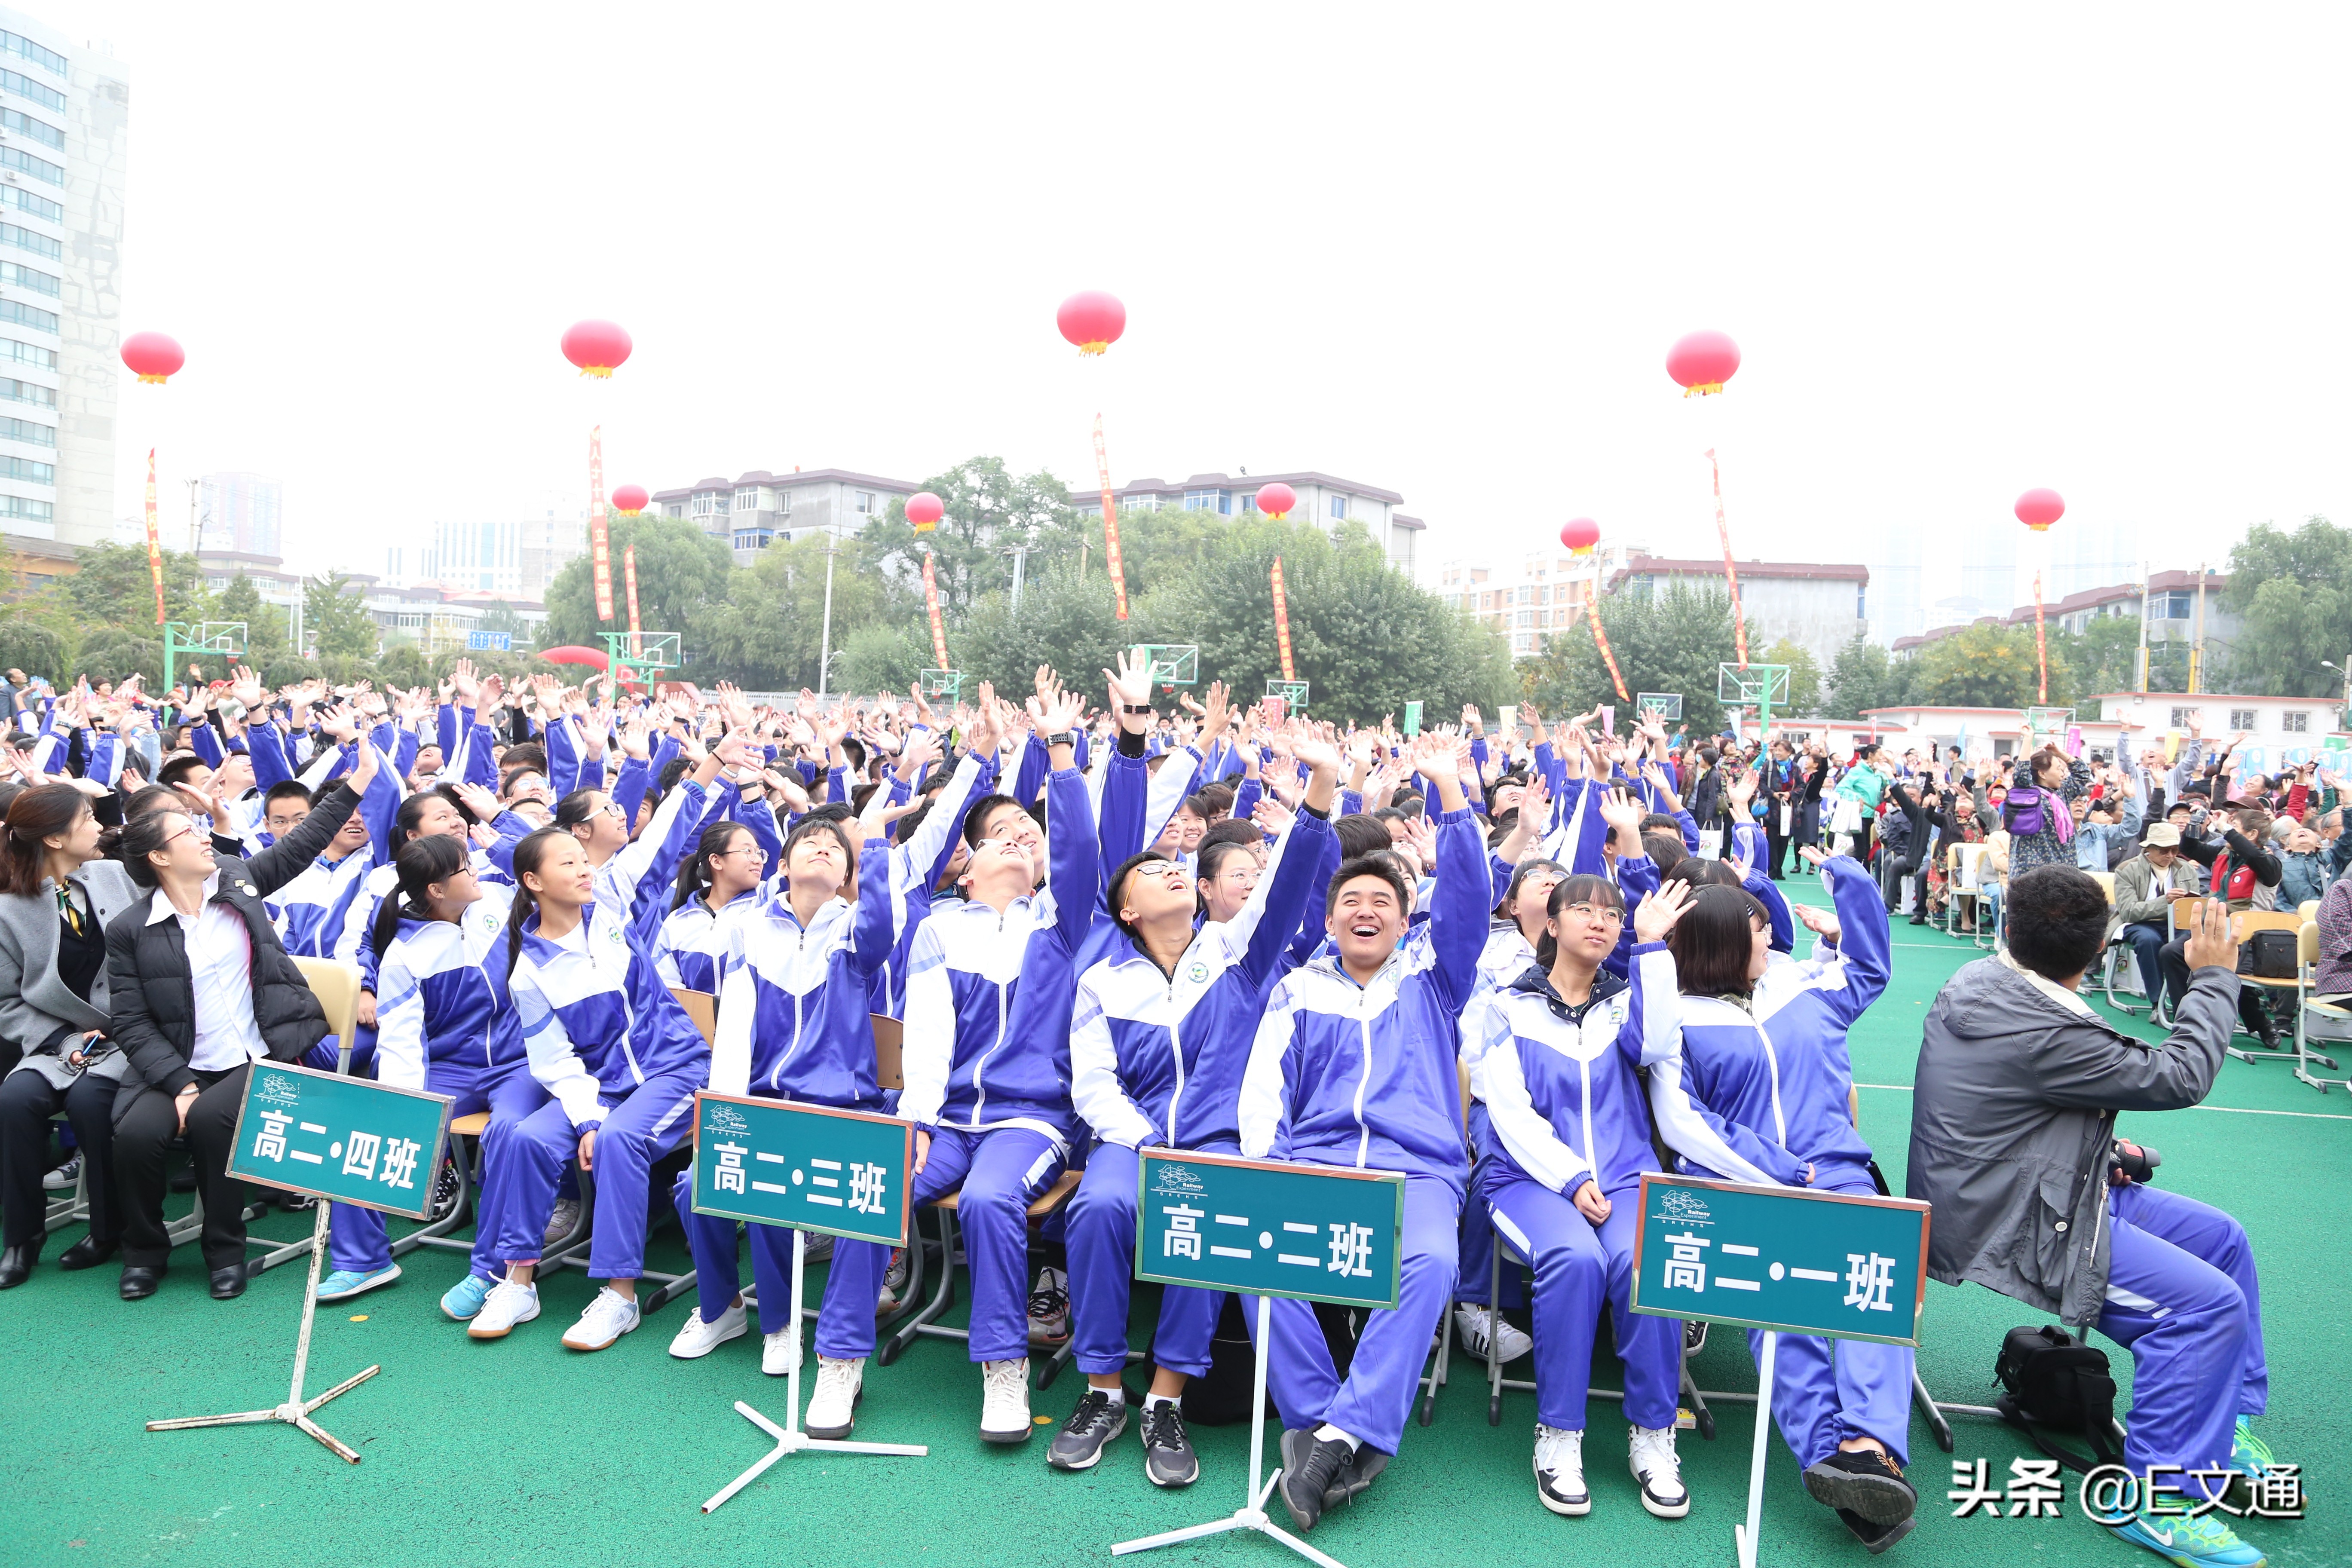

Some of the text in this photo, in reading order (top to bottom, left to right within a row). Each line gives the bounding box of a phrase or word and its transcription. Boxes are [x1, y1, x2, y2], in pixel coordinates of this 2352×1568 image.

[1278, 624, 1294, 681] 书香溢校园
